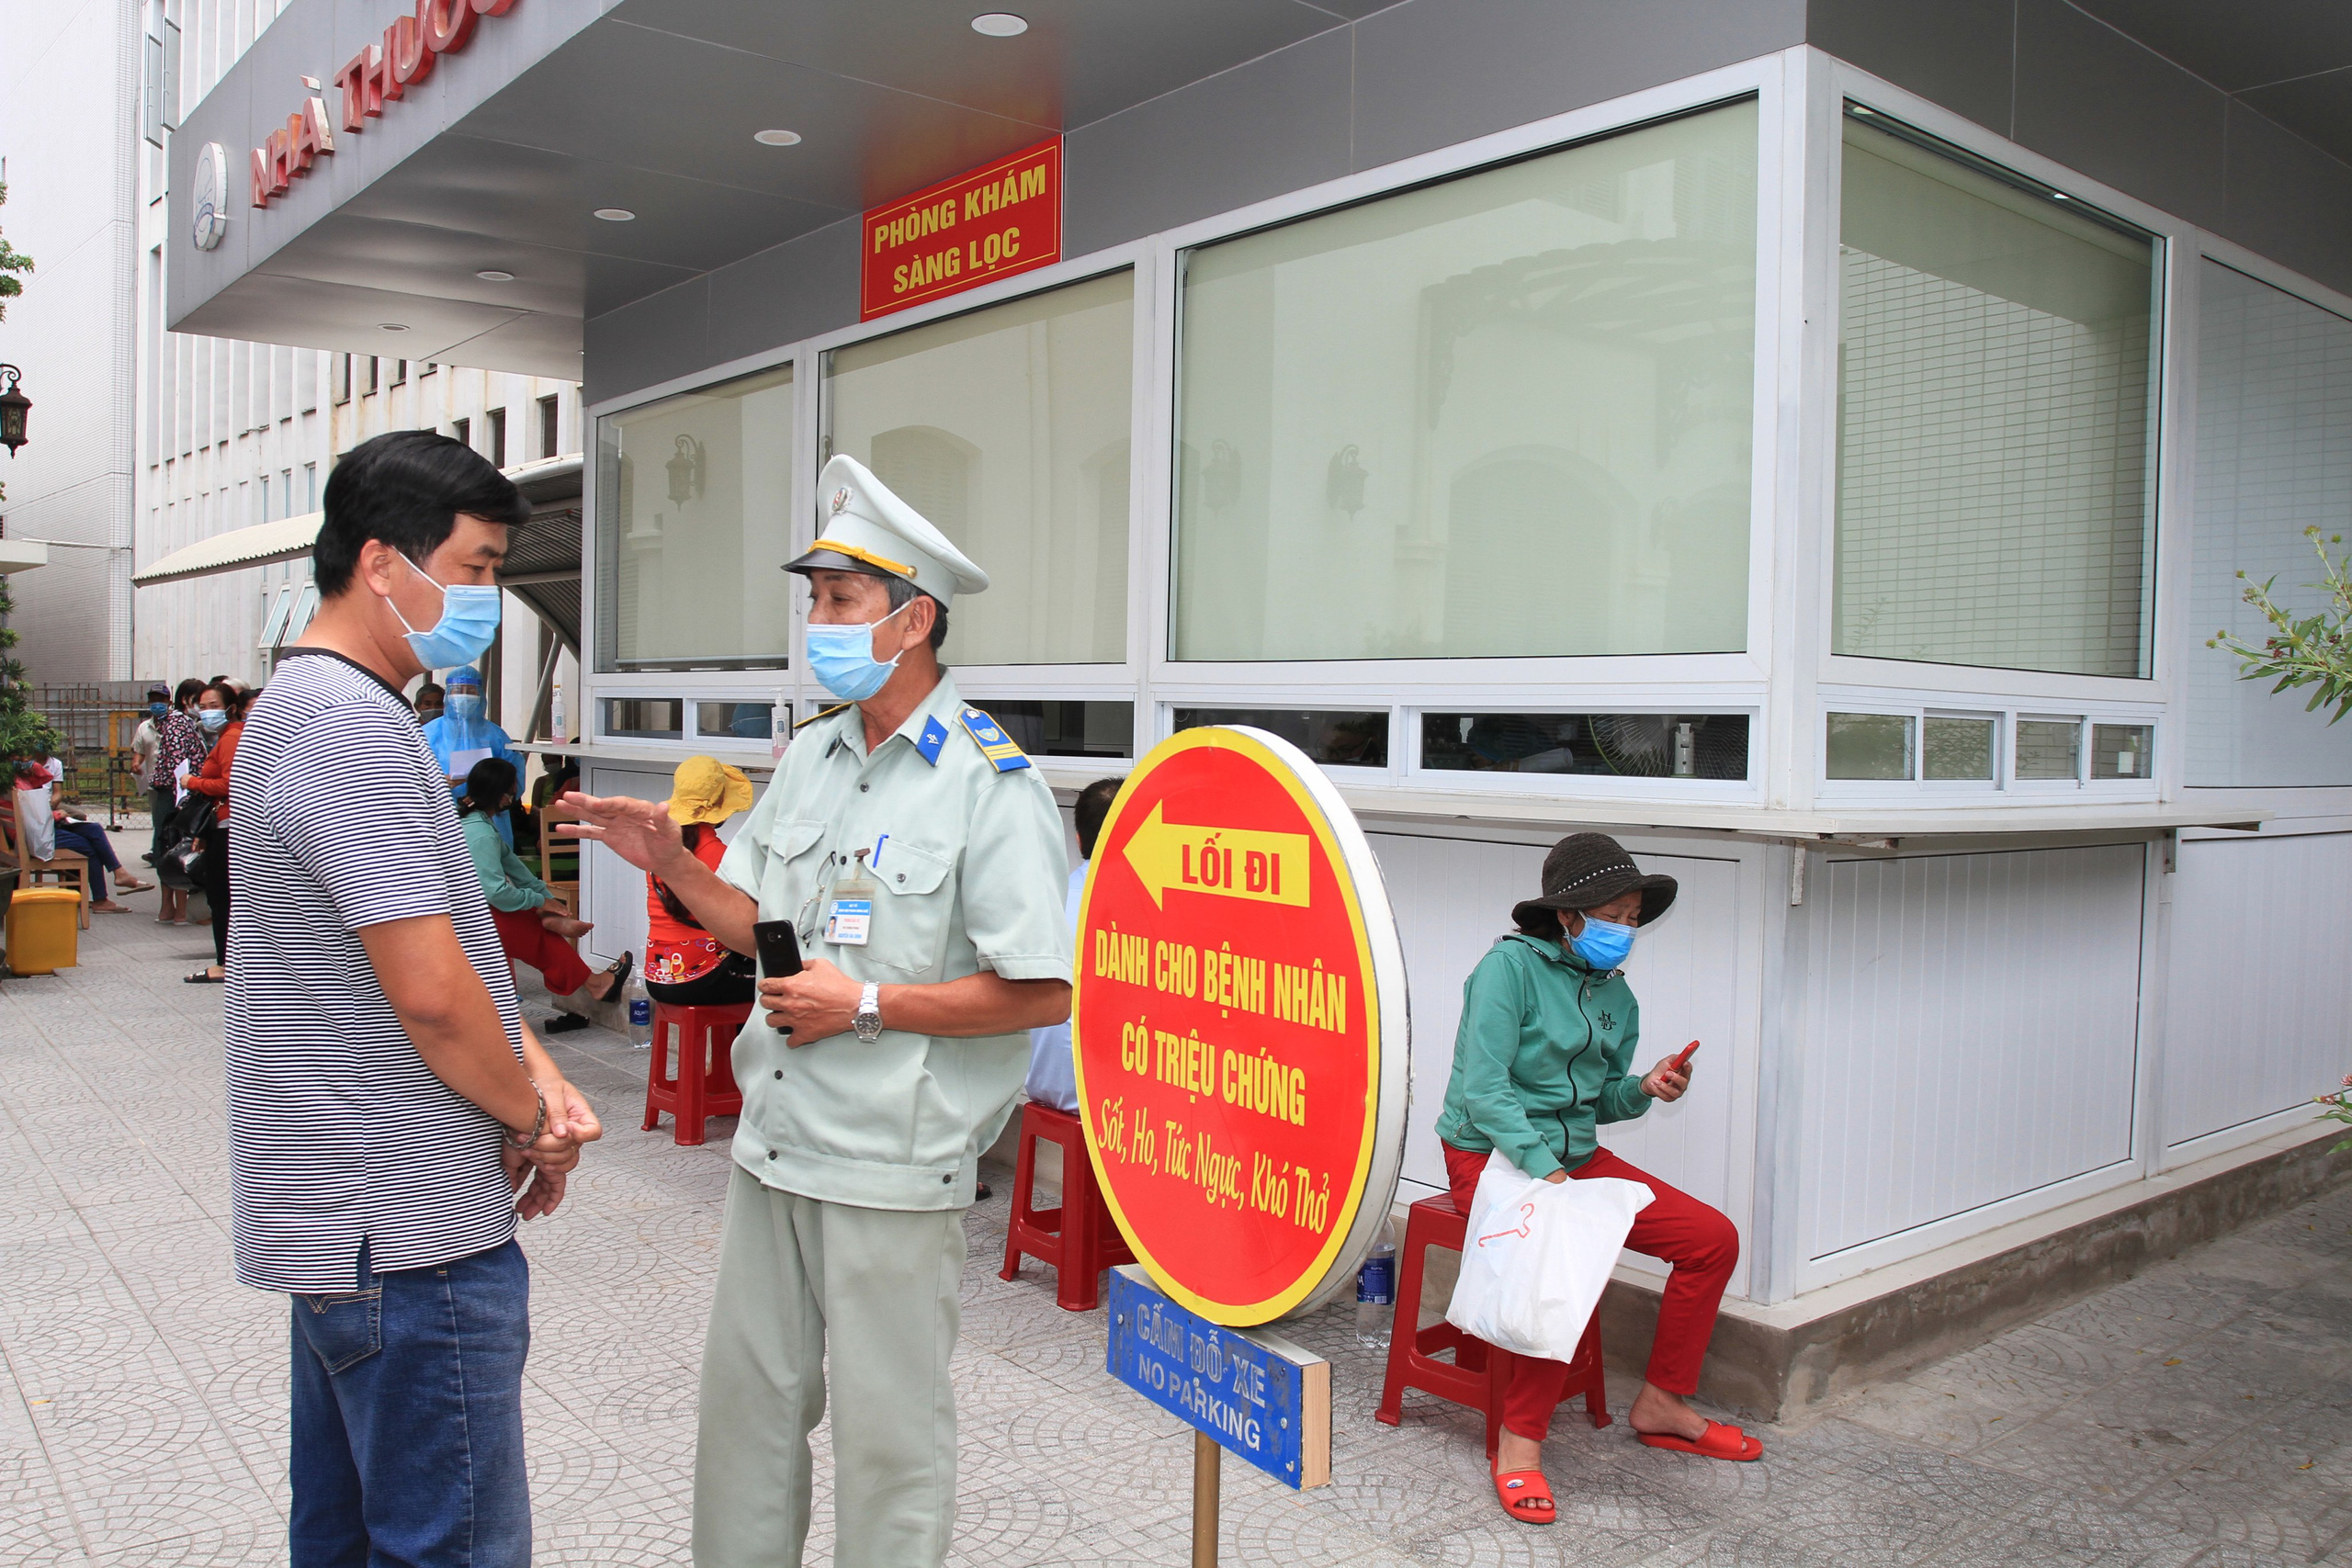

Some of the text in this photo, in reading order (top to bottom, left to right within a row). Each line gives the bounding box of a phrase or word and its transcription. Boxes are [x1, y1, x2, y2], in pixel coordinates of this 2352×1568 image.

[251, 74, 334, 209] NHÀ
[875, 164, 1046, 254] PHÒNG KHÁM
[893, 227, 1020, 294] SÀNG LỌC
[1182, 832, 1280, 896] LỐI ĐI
[1095, 920, 1346, 1034] DÀNH CHO BỆNH NHÂN
[1121, 1015, 1306, 1127] CÓ TRIỆU CHỨNG
[1098, 1096, 1330, 1235] Sốt, Ho, Tức Ngực, Khó Thở
[1136, 1303, 1266, 1409] CẤM ĐỖ XE
[1138, 1353, 1261, 1452] NO PARKING
